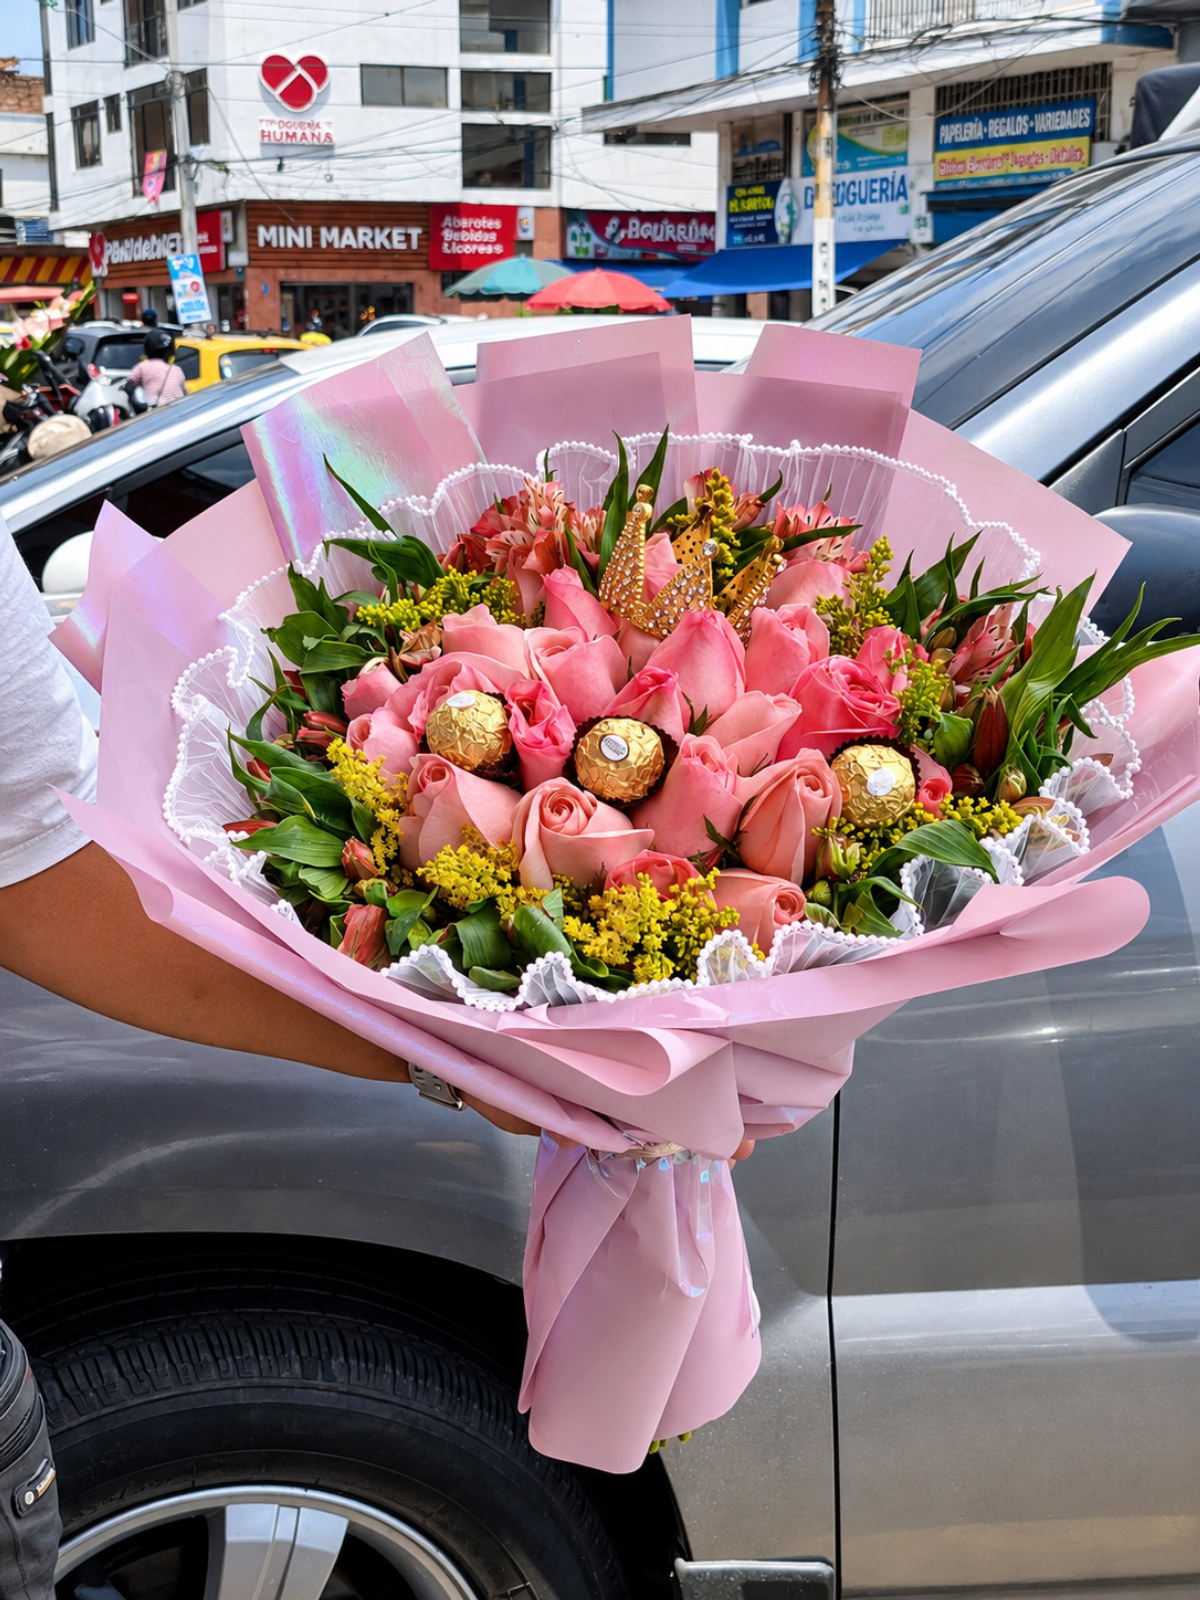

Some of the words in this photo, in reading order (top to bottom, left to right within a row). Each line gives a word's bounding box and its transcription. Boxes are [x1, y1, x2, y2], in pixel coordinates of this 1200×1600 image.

[939, 117, 984, 144] PAPELERÍA
[987, 114, 1029, 139] REGALOS
[1034, 107, 1091, 133] VARIEDADES
[256, 224, 313, 248] MINI
[319, 225, 423, 250] MARKET
